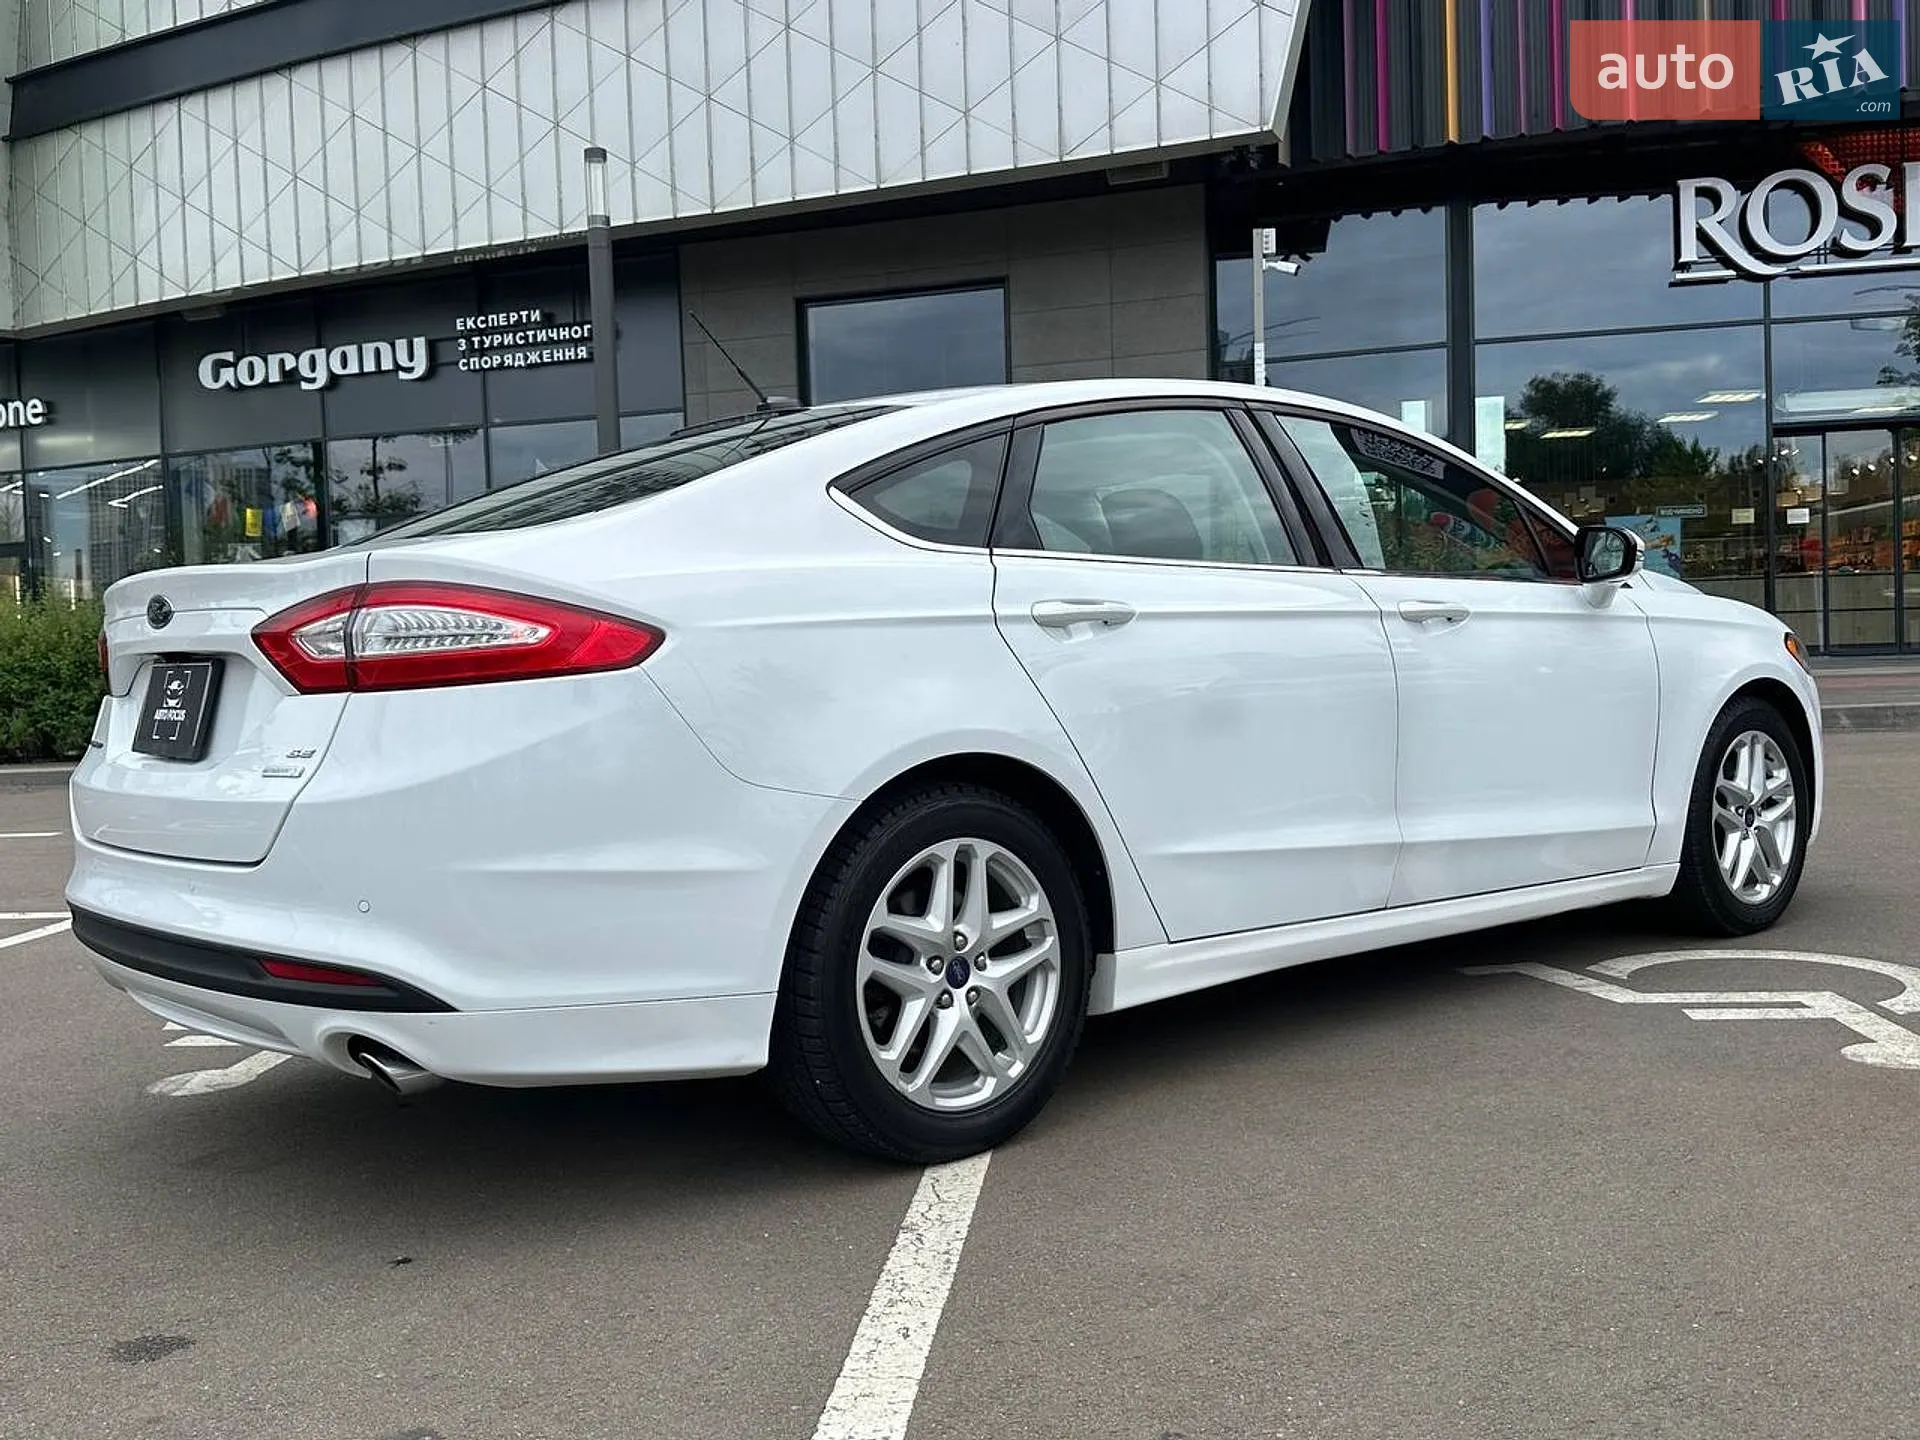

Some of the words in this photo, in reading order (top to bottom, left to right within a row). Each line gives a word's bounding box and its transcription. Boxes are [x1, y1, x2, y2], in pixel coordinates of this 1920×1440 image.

[455, 309, 541, 331] ЕКСПЕРТИ
[198, 336, 428, 390] Gorgany
[458, 346, 587, 371] СПОРЯДЖЕННЯ
